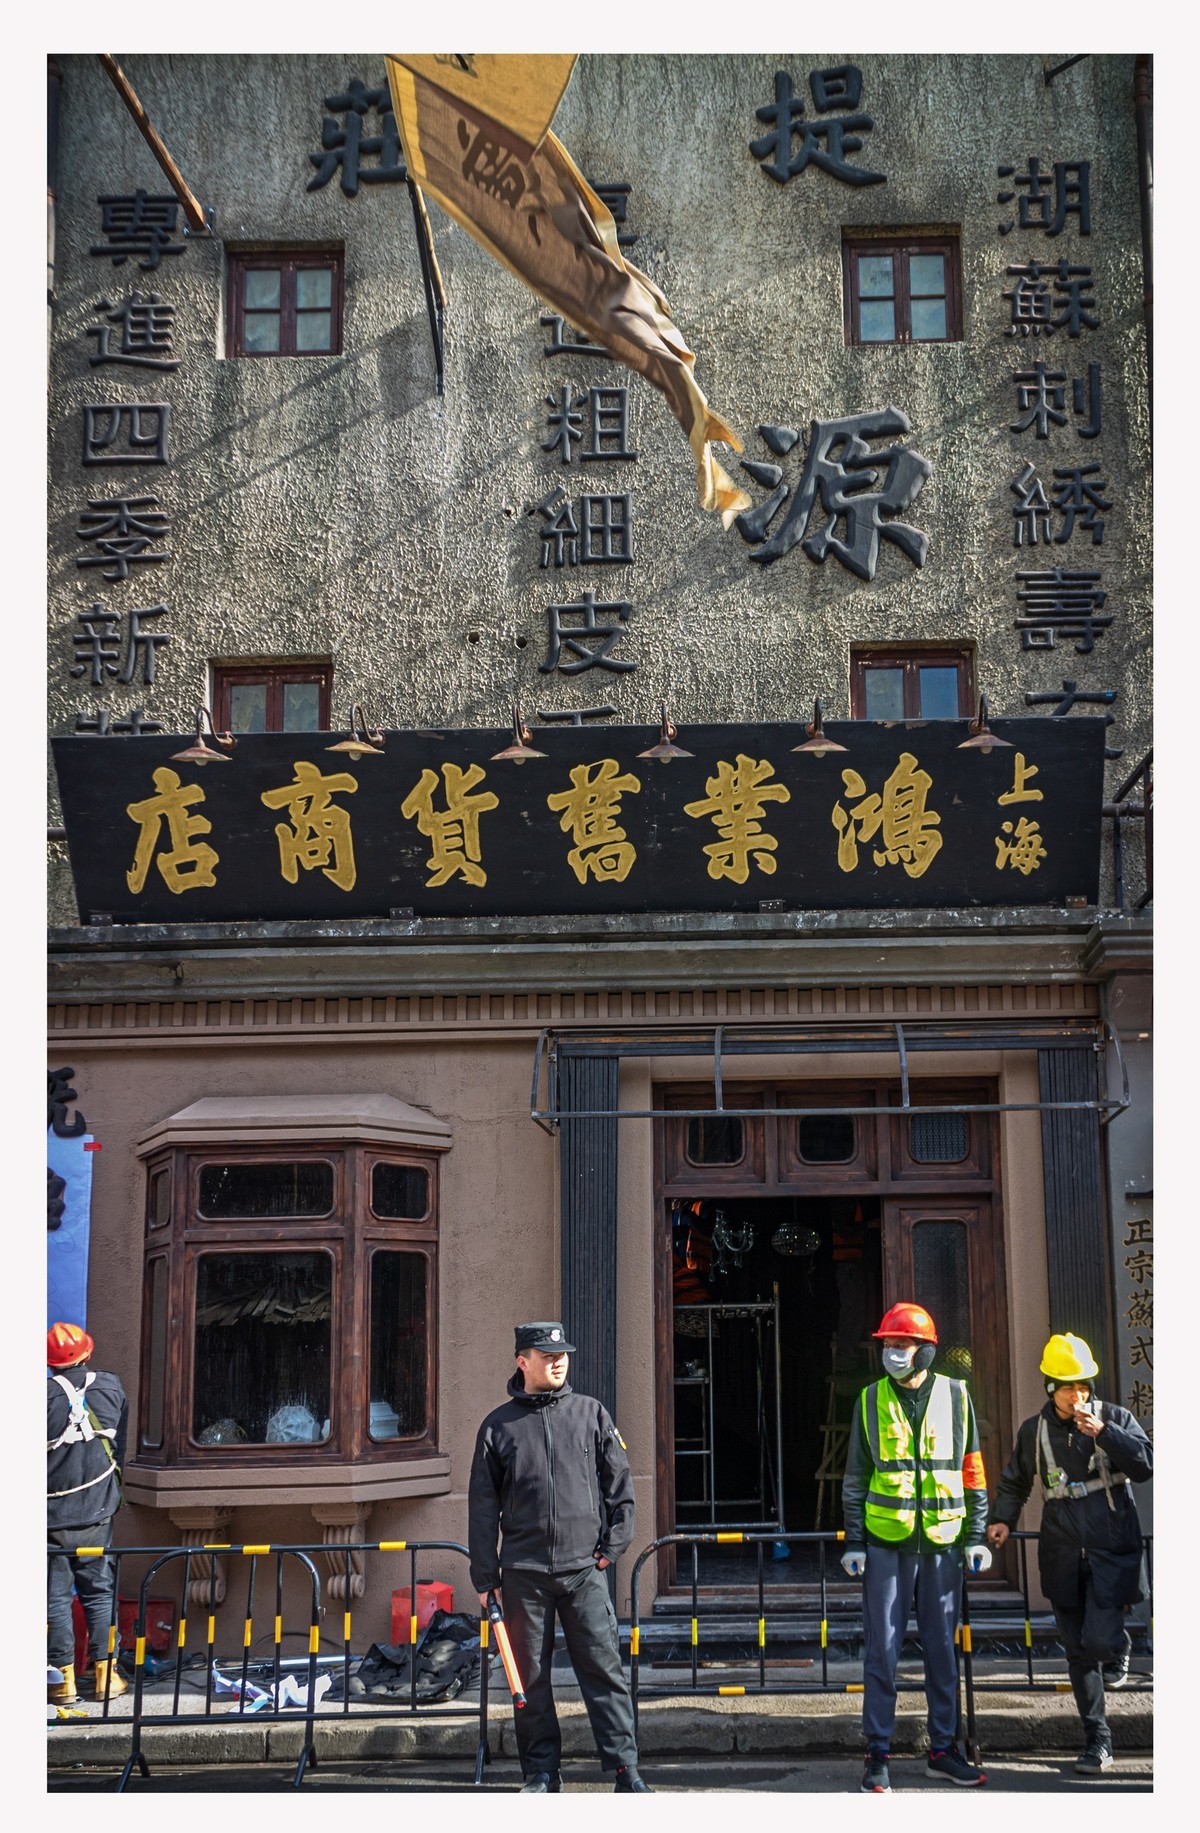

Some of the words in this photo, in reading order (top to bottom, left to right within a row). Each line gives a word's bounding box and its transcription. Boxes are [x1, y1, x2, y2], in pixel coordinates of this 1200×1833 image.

[749, 63, 887, 187] 提
[736, 406, 932, 583] 源
[995, 752, 1048, 875] 上海
